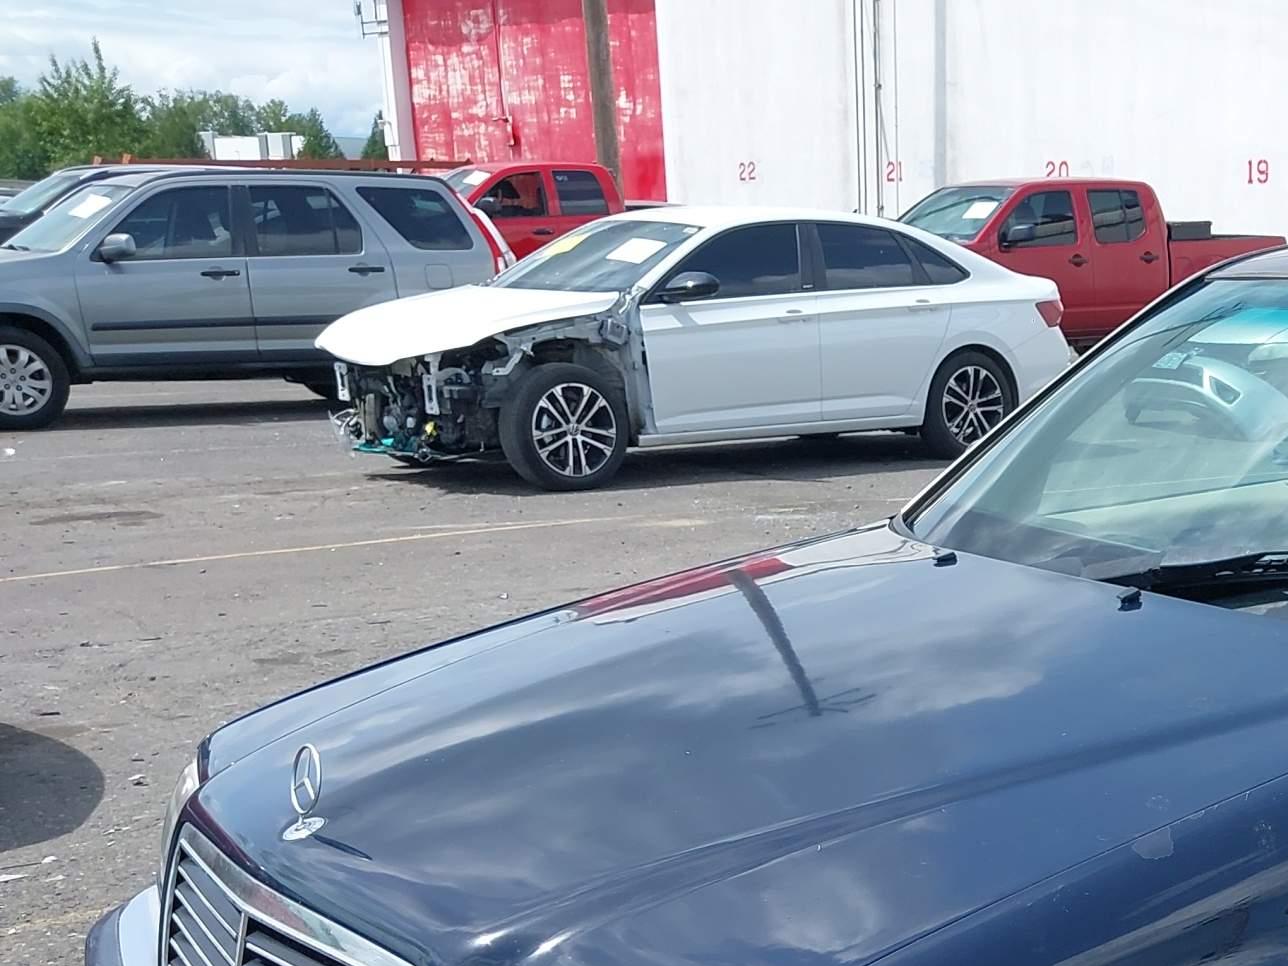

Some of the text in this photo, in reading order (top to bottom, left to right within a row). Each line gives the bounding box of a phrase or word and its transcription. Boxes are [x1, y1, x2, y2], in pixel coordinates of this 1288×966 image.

[738, 161, 757, 181] 22
[886, 160, 903, 182] 21
[1045, 160, 1069, 177] 20
[1247, 159, 1269, 185] 19
